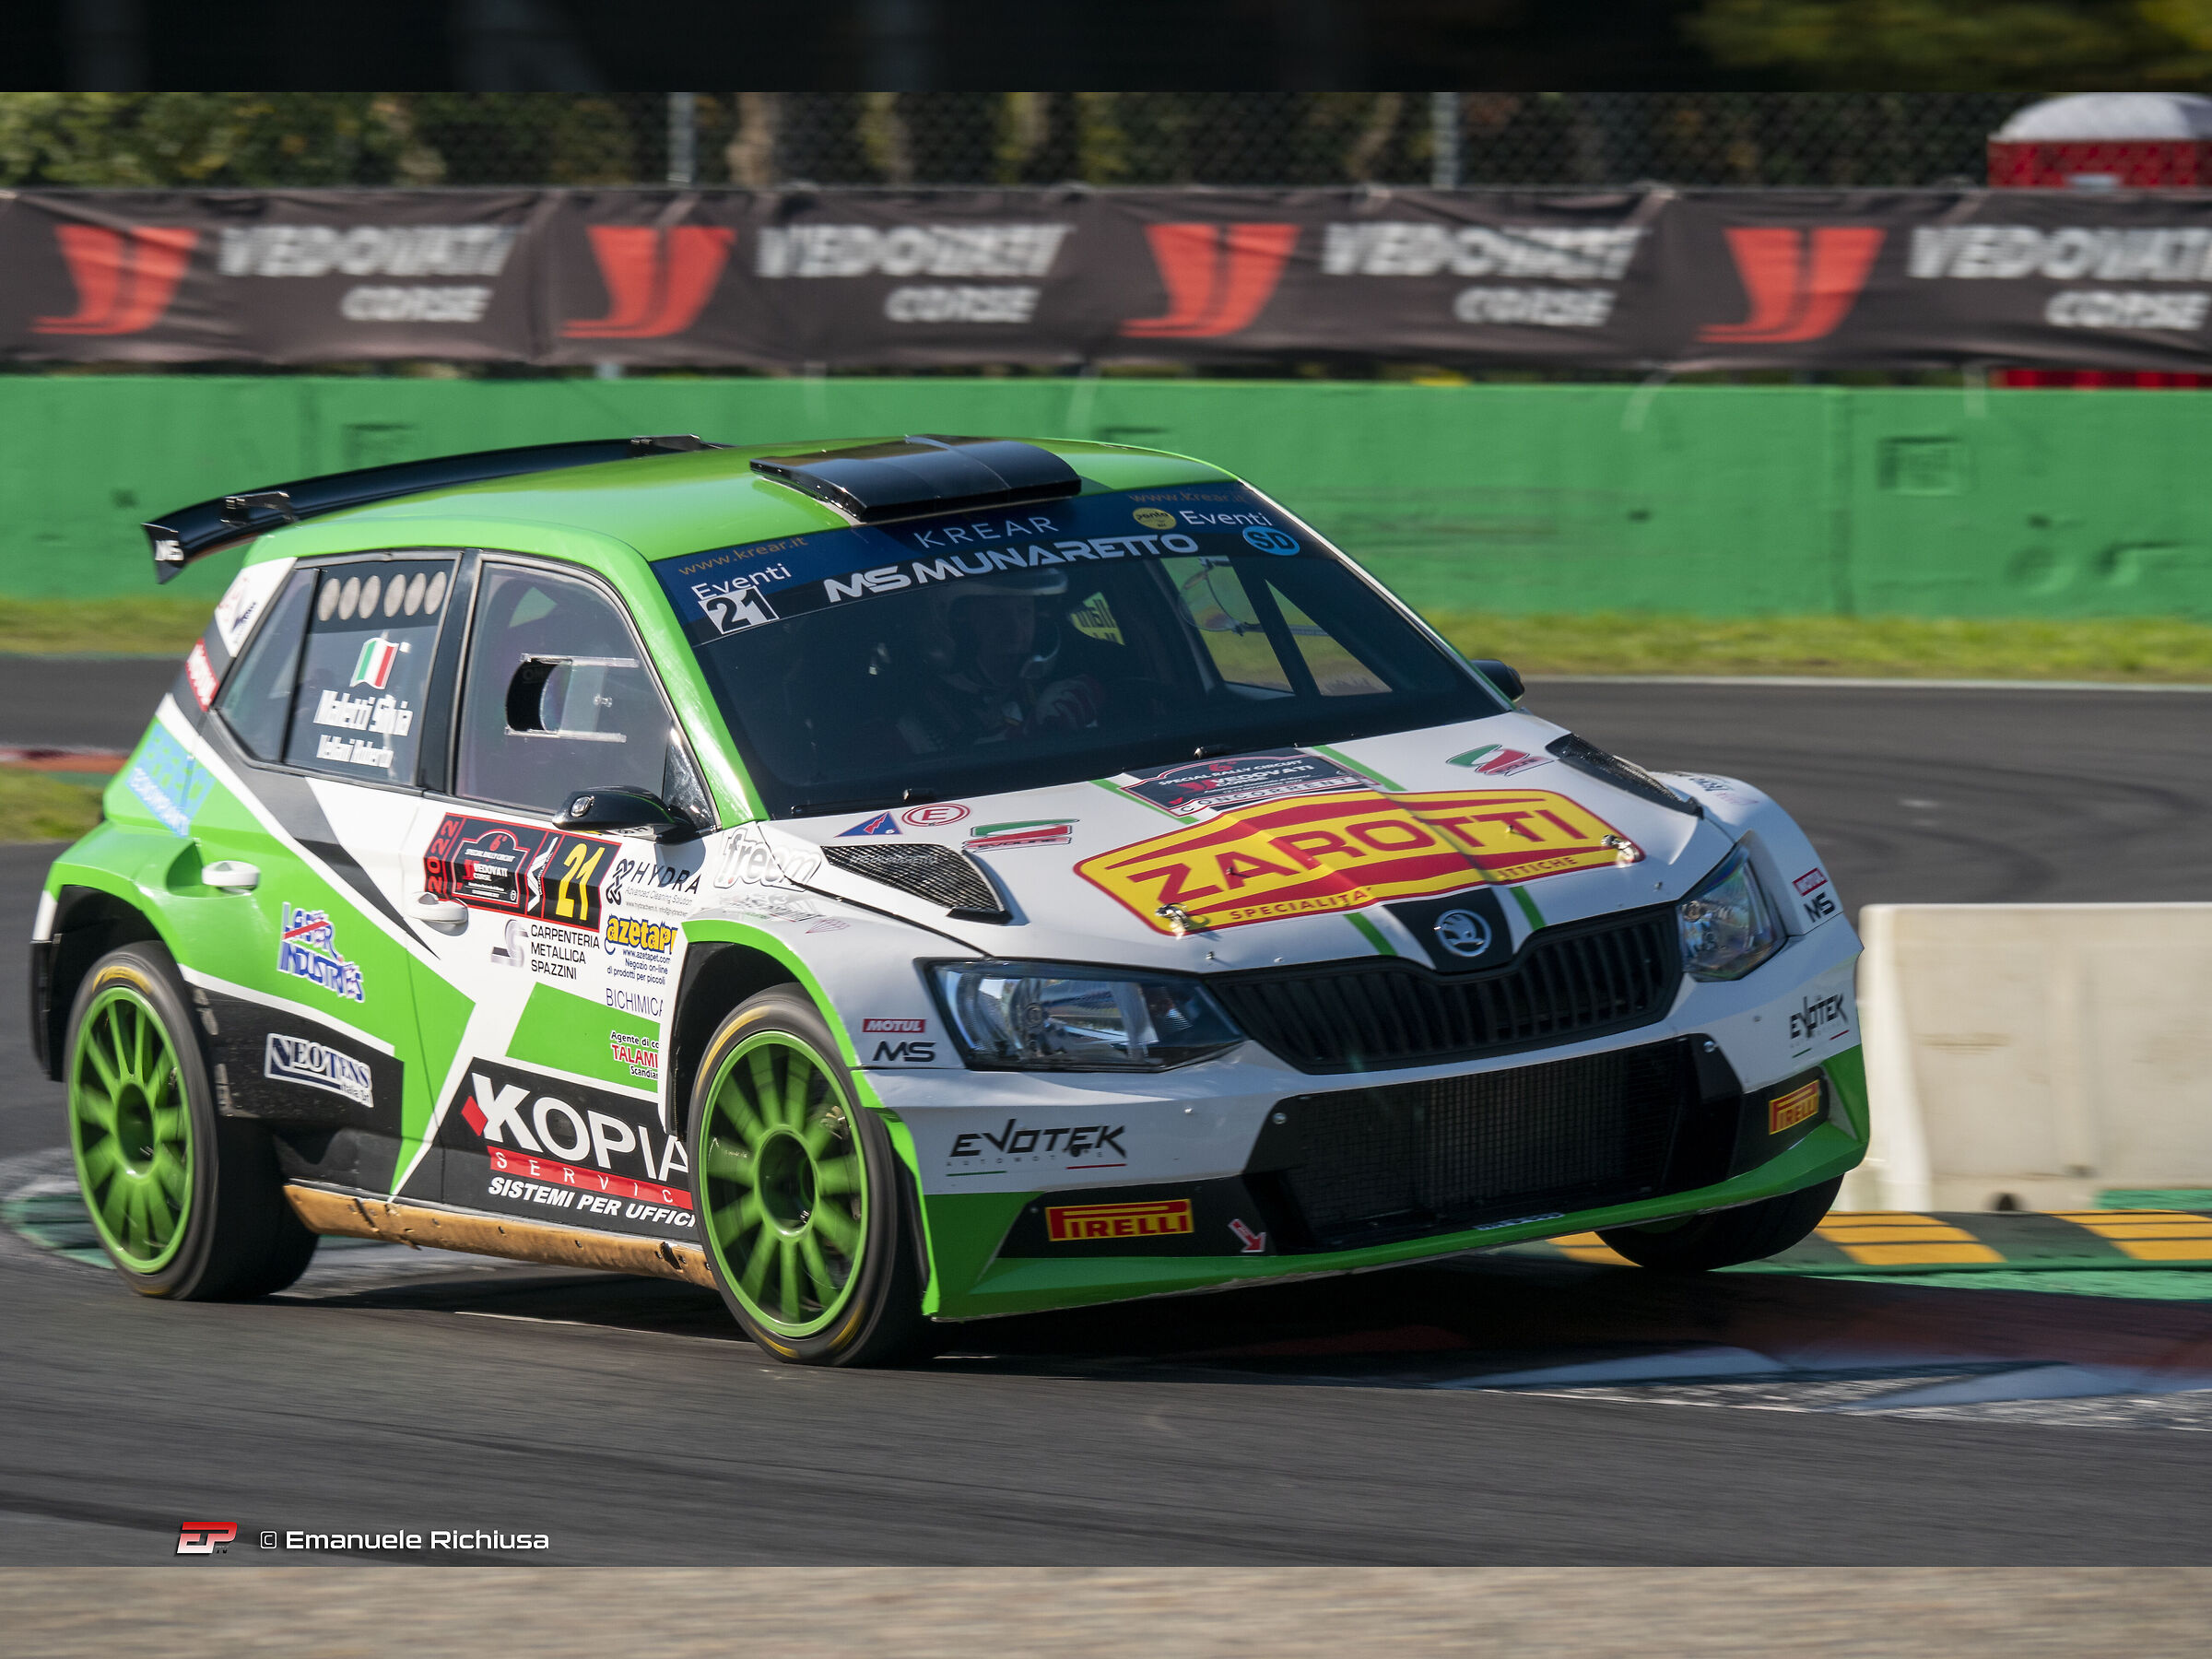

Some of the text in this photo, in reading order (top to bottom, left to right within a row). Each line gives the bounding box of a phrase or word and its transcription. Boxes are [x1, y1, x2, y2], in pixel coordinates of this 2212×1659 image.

[914, 517, 1059, 548] KREAR
[1179, 511, 1274, 526] Eventi
[678, 536, 808, 575] www.krear.it
[822, 534, 1198, 604] MS MUNARETTO
[691, 563, 793, 601] Eventi
[705, 588, 772, 633] 21
[922, 808, 949, 821] E
[424, 818, 459, 894] 2022
[1126, 809, 1588, 905] ZAROTTI
[1498, 856, 1578, 878] ITTICHE
[556, 841, 606, 921] 21
[630, 861, 702, 895] HYDRA
[1803, 891, 1836, 923] MS
[531, 924, 600, 949] CARPENTERIA
[531, 942, 586, 964] METALLICA
[625, 958, 648, 971] Negozio
[531, 959, 577, 981] SPAZZINI
[613, 968, 636, 979] prodotti
[636, 972, 646, 981] per
[611, 1030, 640, 1043] Agente
[641, 1038, 650, 1047] di
[865, 1019, 924, 1031] MOTUL
[873, 1041, 936, 1062] MS
[1771, 1081, 1819, 1134] PIRELLI
[950, 1118, 1127, 1159] EVOTEK
[488, 1177, 576, 1208] SISTEMI
[576, 1194, 620, 1217] PER
[1049, 1200, 1190, 1240] PIRELLI
